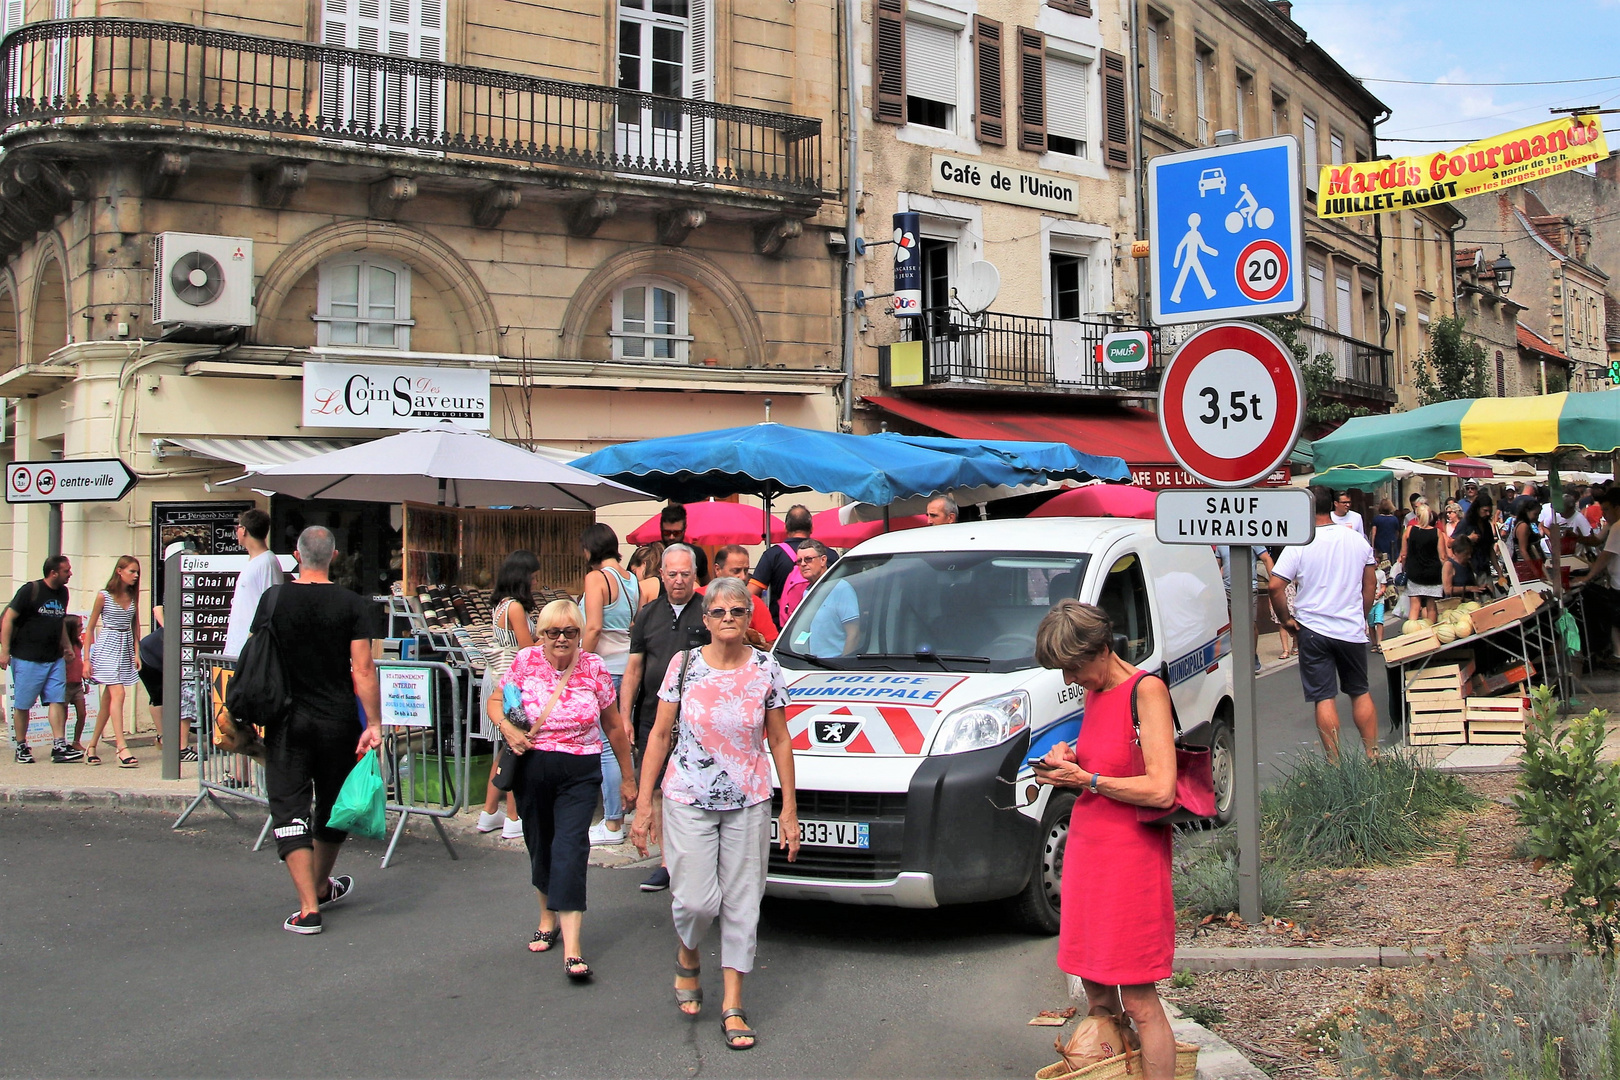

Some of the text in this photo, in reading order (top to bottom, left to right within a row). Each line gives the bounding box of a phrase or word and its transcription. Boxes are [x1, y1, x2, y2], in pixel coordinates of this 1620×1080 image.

[1328, 120, 1600, 196] Mardis Gourmands
[1464, 151, 1600, 195] sur les berges de la Vézère
[1492, 171, 1499, 179] à
[1501, 163, 1529, 178] partir
[1531, 159, 1544, 169] de
[1546, 155, 1558, 165] 19
[940, 160, 1073, 202] Café de l'Union
[1324, 180, 1458, 216] JUILLET-AOÛT
[1248, 258, 1278, 282] 20
[1110, 348, 1128, 357] PMU
[310, 374, 485, 417] Le Coin Des Saveurs
[417, 410, 483, 418] BUGUOISES
[1199, 386, 1263, 430] 3,5t
[60, 474, 114, 487] centre-ville
[1131, 472, 1151, 486] AFE
[1156, 472, 1171, 485] DE
[1206, 497, 1259, 514] SAUF
[1178, 519, 1288, 537] LIVRAISON
[183, 557, 210, 571] Église
[197, 577, 221, 587] Chai
[197, 595, 226, 606] Hôtel
[197, 613, 231, 626] Crêperi
[197, 632, 228, 642] La Piz
[1169, 650, 1204, 684] MUNICIPALE
[825, 676, 929, 684] POLICE
[788, 687, 941, 700] MUNICIPALE
[1057, 684, 1084, 704] LE BUG
